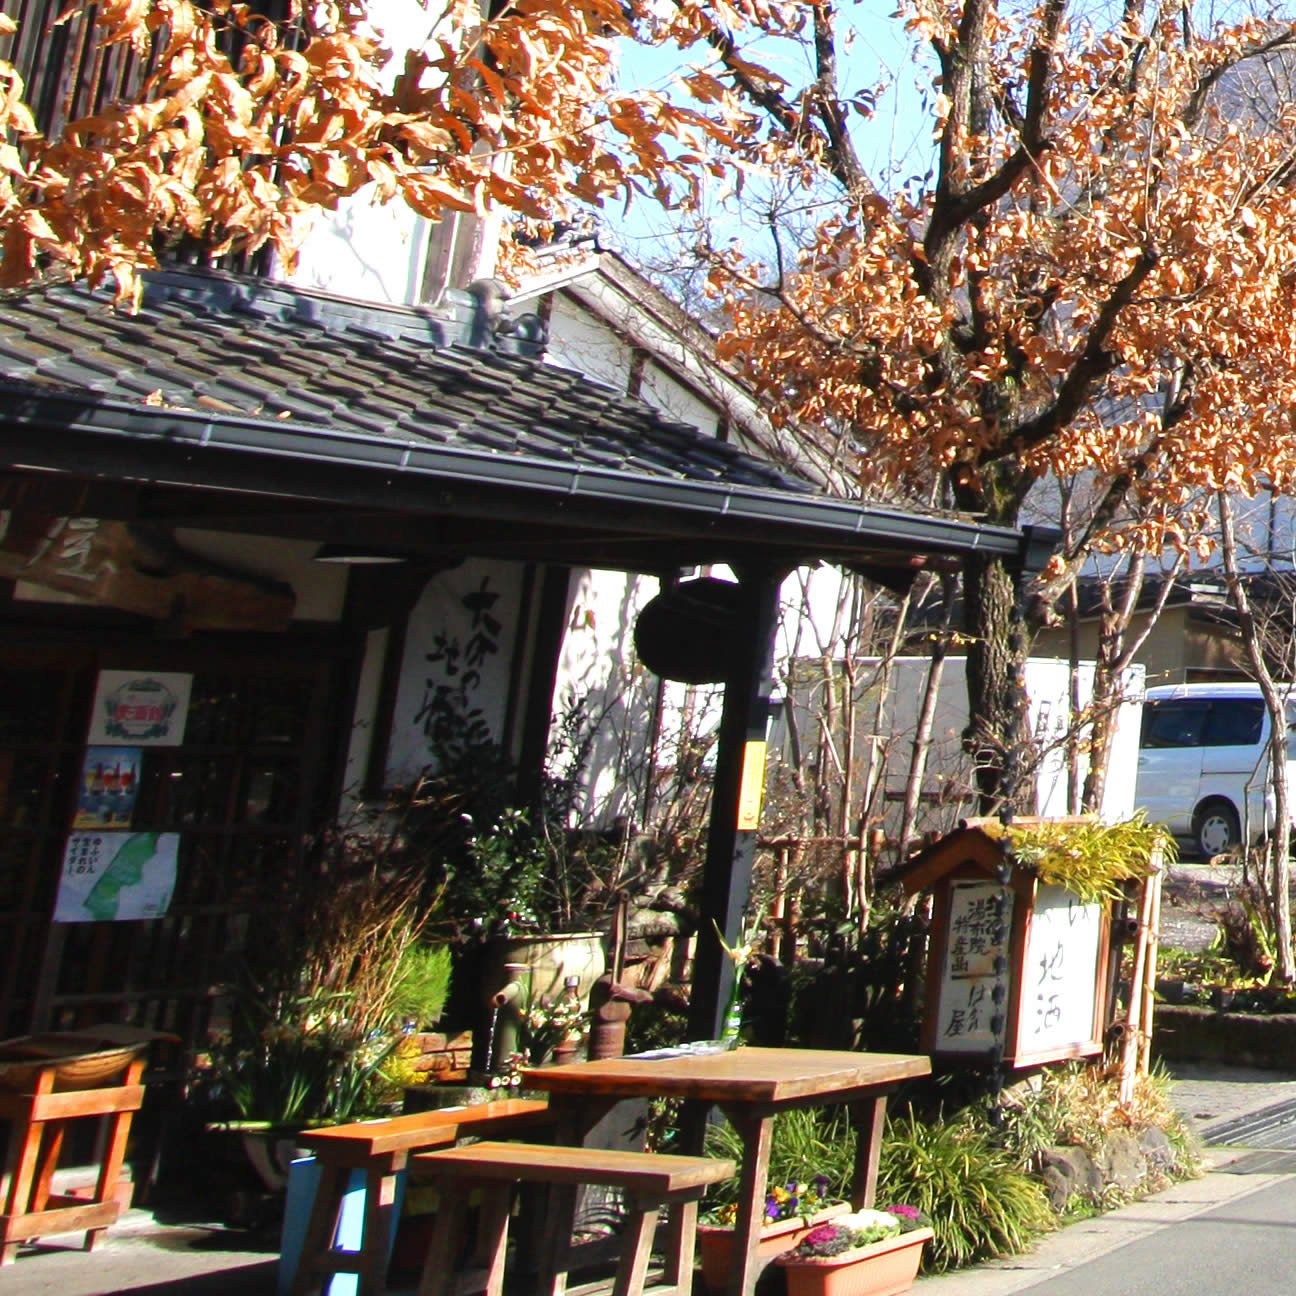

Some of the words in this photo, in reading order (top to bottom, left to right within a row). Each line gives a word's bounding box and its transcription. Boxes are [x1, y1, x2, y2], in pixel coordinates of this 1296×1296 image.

[951, 914, 970, 973] 特産品
[967, 898, 989, 956] 湯布院
[1034, 939, 1065, 1035] 地酒
